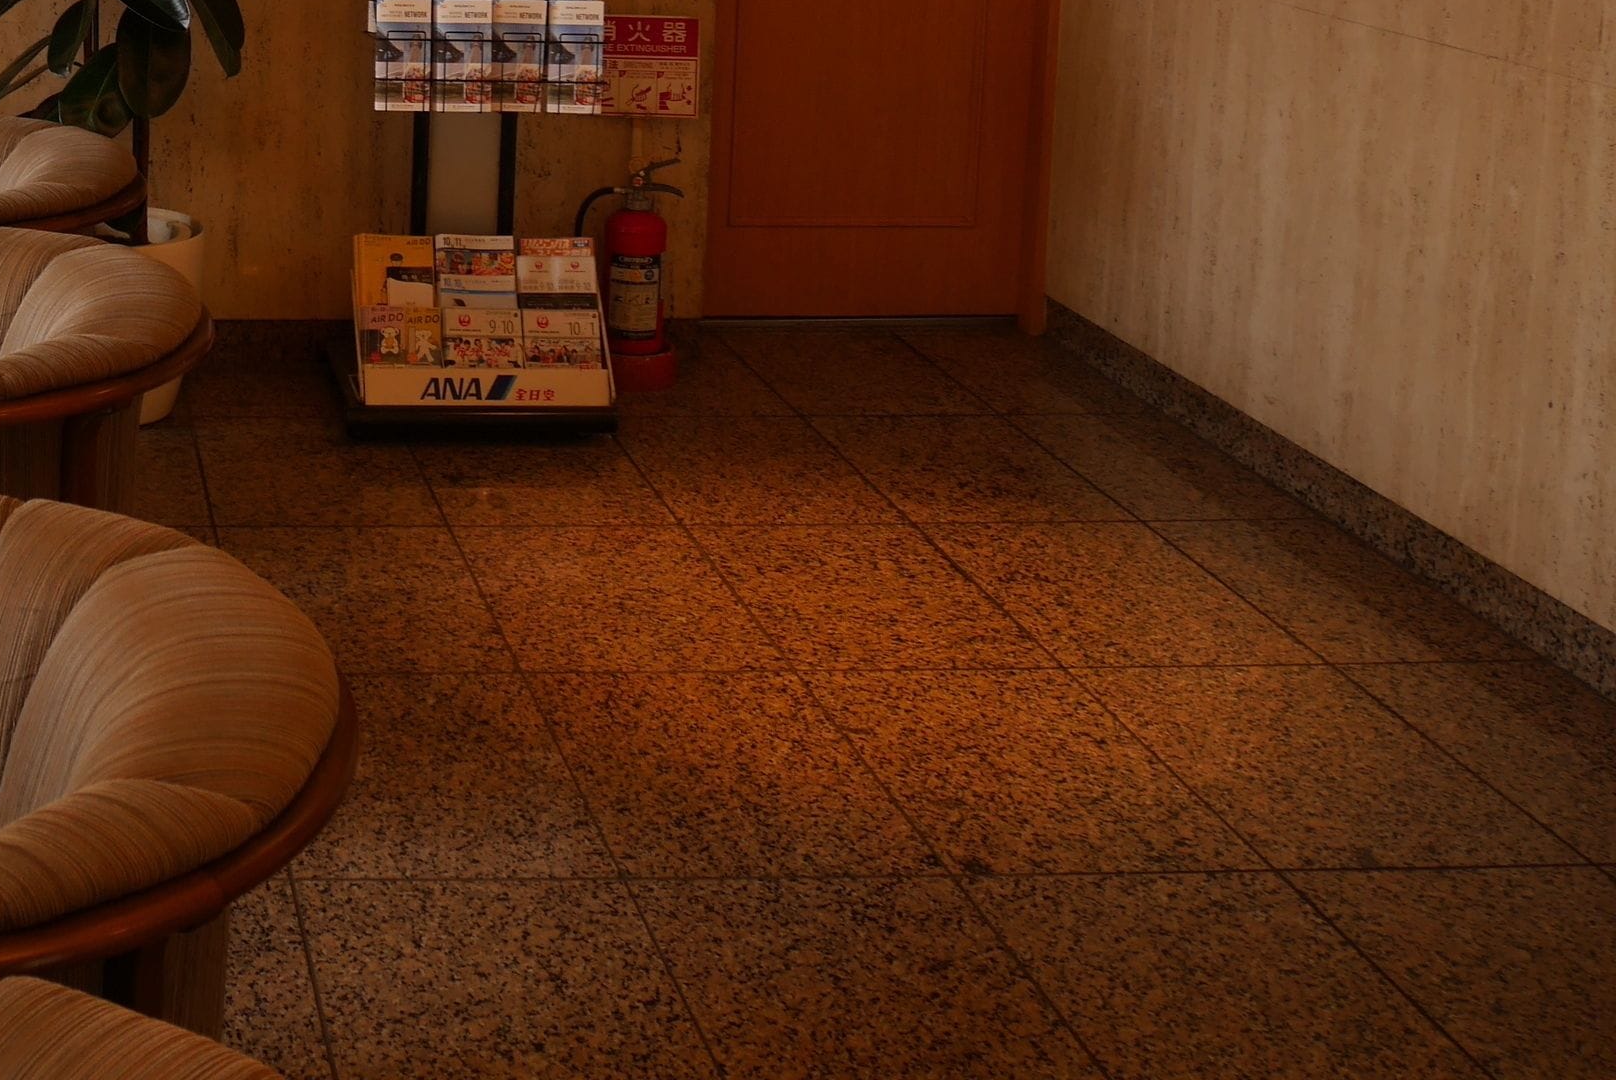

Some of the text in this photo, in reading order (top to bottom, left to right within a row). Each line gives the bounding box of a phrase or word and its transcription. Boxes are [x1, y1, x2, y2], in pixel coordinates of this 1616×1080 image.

[464, 11, 488, 19] NETWORK
[519, 12, 543, 20] NETWORK
[576, 13, 599, 21] NETWORK
[617, 44, 687, 53] EXTINGUISHER
[371, 312, 404, 324] AIR DO
[407, 314, 440, 325] AIR DO
[420, 378, 482, 400] ANA
[515, 388, 555, 401] 全日空
